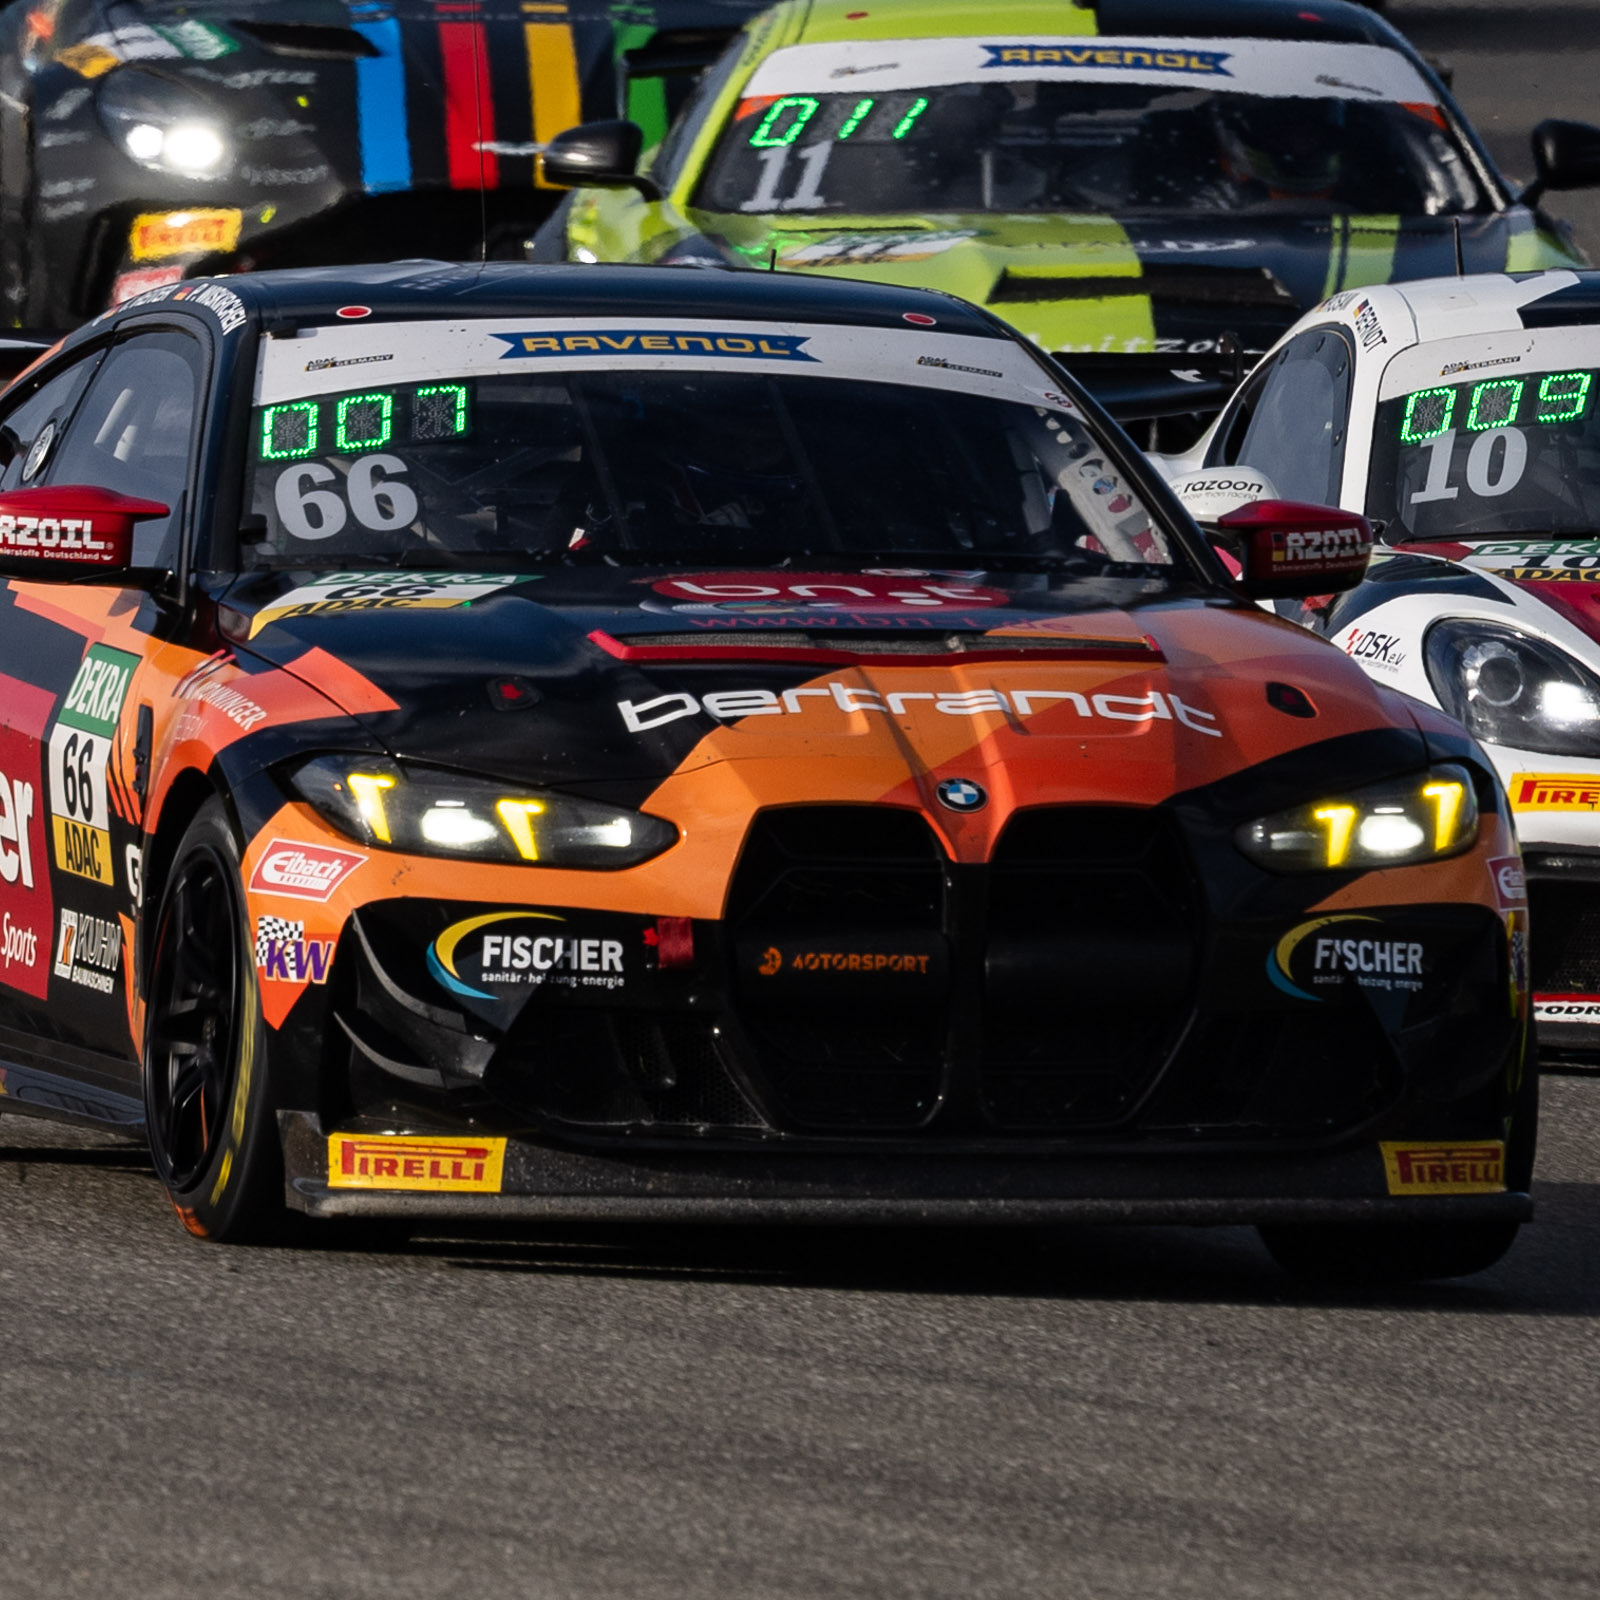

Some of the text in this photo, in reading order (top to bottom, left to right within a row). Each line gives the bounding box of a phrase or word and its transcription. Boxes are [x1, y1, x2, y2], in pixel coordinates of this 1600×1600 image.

[1000, 45, 1215, 71] RAVENOL
[748, 95, 930, 148] 011
[739, 139, 834, 212] 11
[522, 334, 791, 356] RAVENOL
[262, 384, 468, 461] 007
[1400, 371, 1593, 443] 009
[1183, 479, 1264, 495] razoon
[1409, 425, 1528, 504] 10
[274, 453, 419, 541] 66
[43, 548, 100, 561] Deutschland
[314, 571, 521, 585] DEKRA
[279, 598, 424, 619] ADAC
[1355, 630, 1401, 662] DSK
[64, 655, 131, 724] DEKRA
[617, 682, 1223, 738] bertrandt
[63, 733, 95, 823] 66
[63, 821, 102, 880] ADAC
[261, 850, 344, 891] Eibach
[0, 911, 38, 969] Sports
[75, 912, 122, 973] KUHN
[264, 939, 336, 985] KW
[482, 935, 624, 973] FISCHER
[1314, 938, 1424, 975] FISCHER
[341, 1140, 489, 1182] PIRELLI
[1394, 1147, 1501, 1185] PIRELLI
